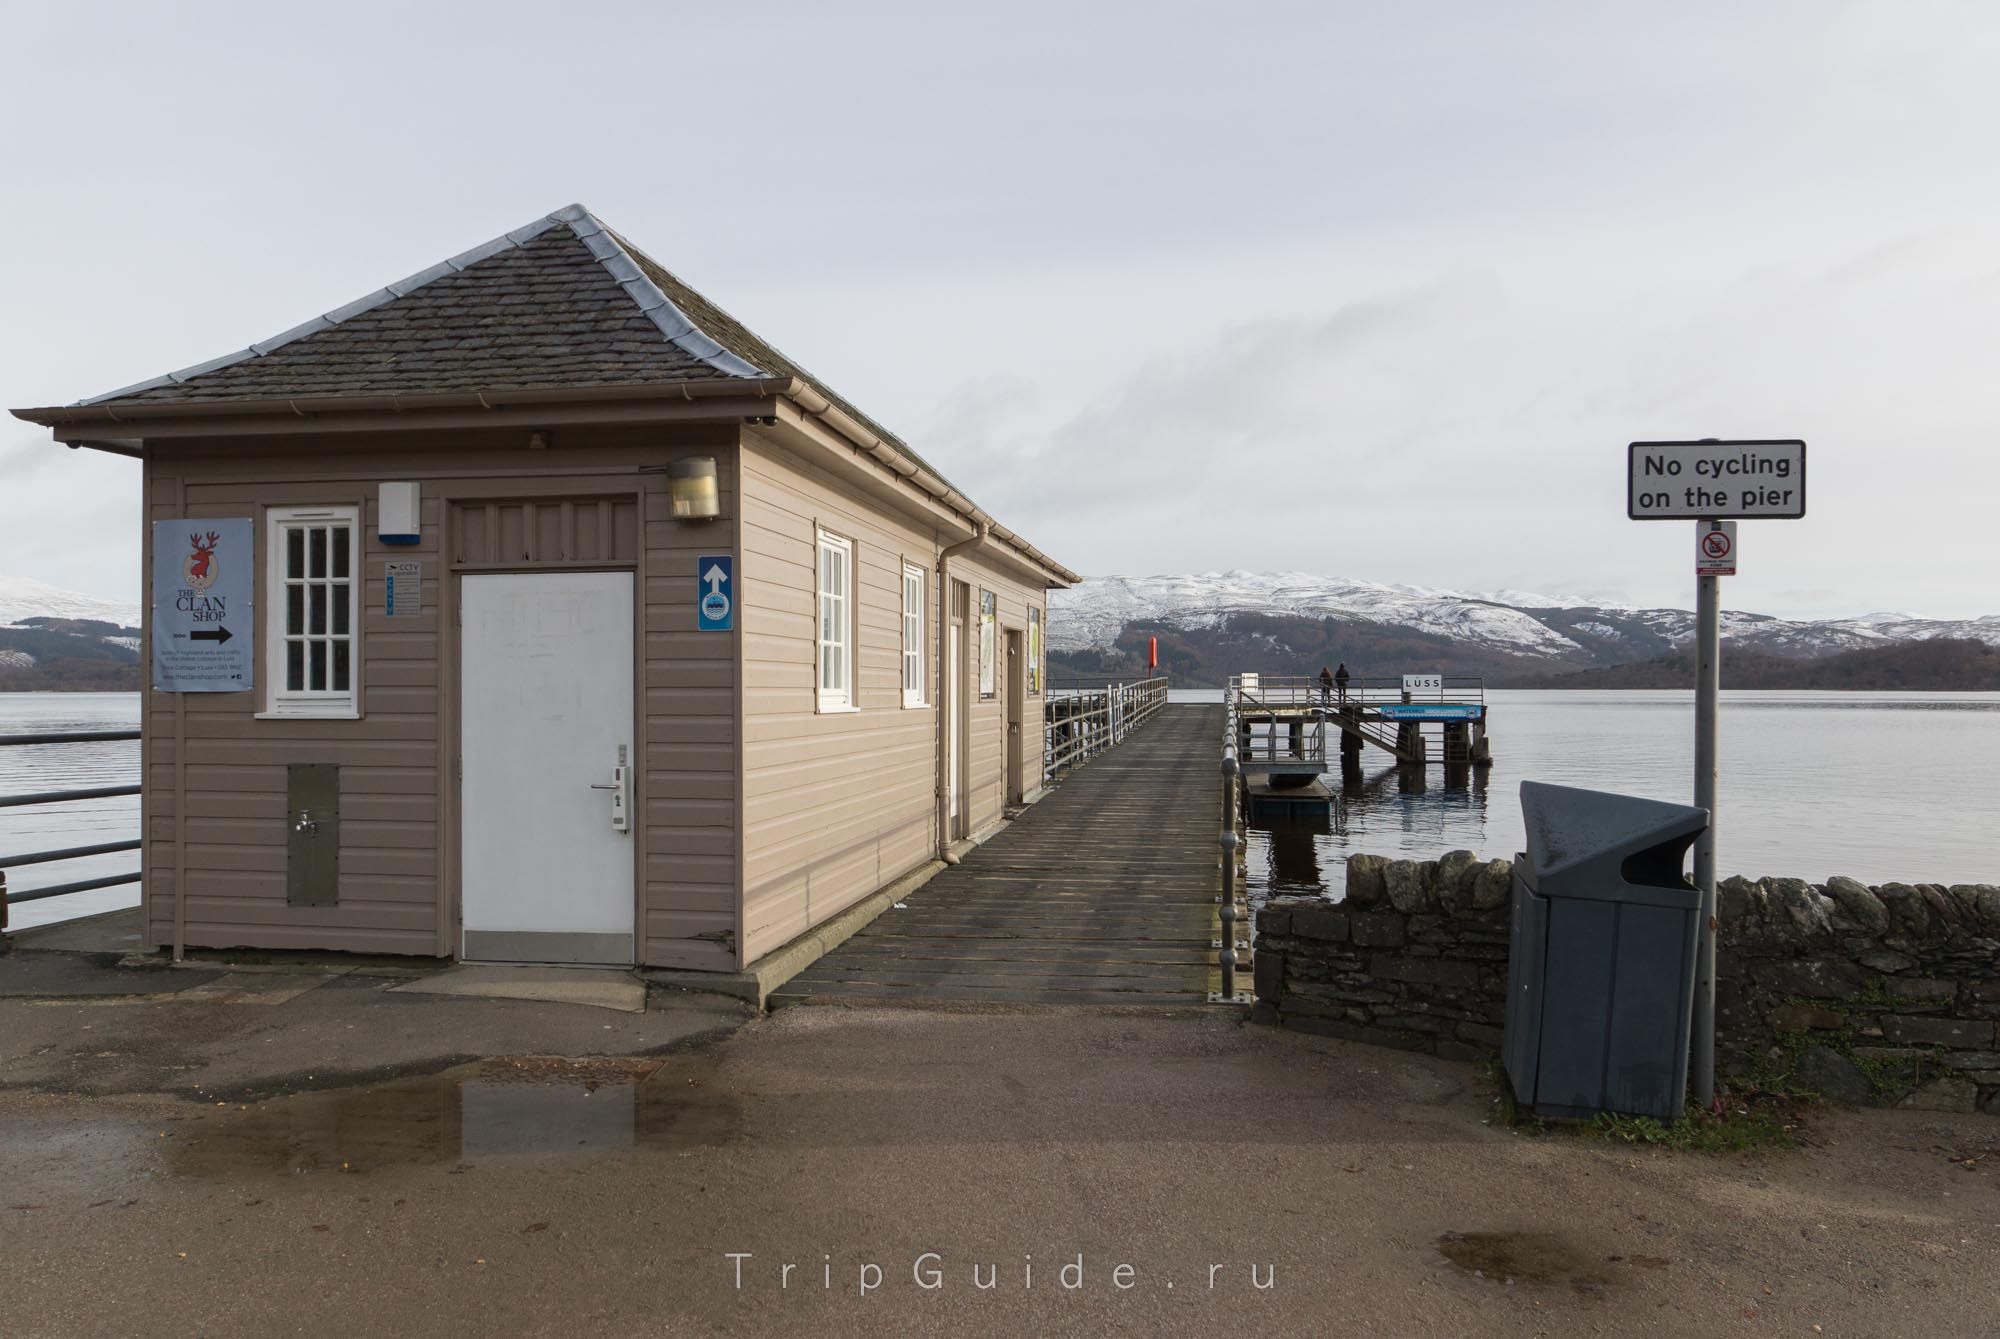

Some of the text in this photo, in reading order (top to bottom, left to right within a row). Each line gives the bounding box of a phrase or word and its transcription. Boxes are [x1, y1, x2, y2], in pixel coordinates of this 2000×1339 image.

[1645, 453, 1791, 479] No cycling
[1639, 485, 1793, 510] on the pier
[399, 563, 419, 571] CCTV
[177, 589, 195, 597] THE
[176, 596, 226, 611] CLAN
[193, 611, 226, 622] SHOP
[1405, 679, 1440, 688] LUSS
